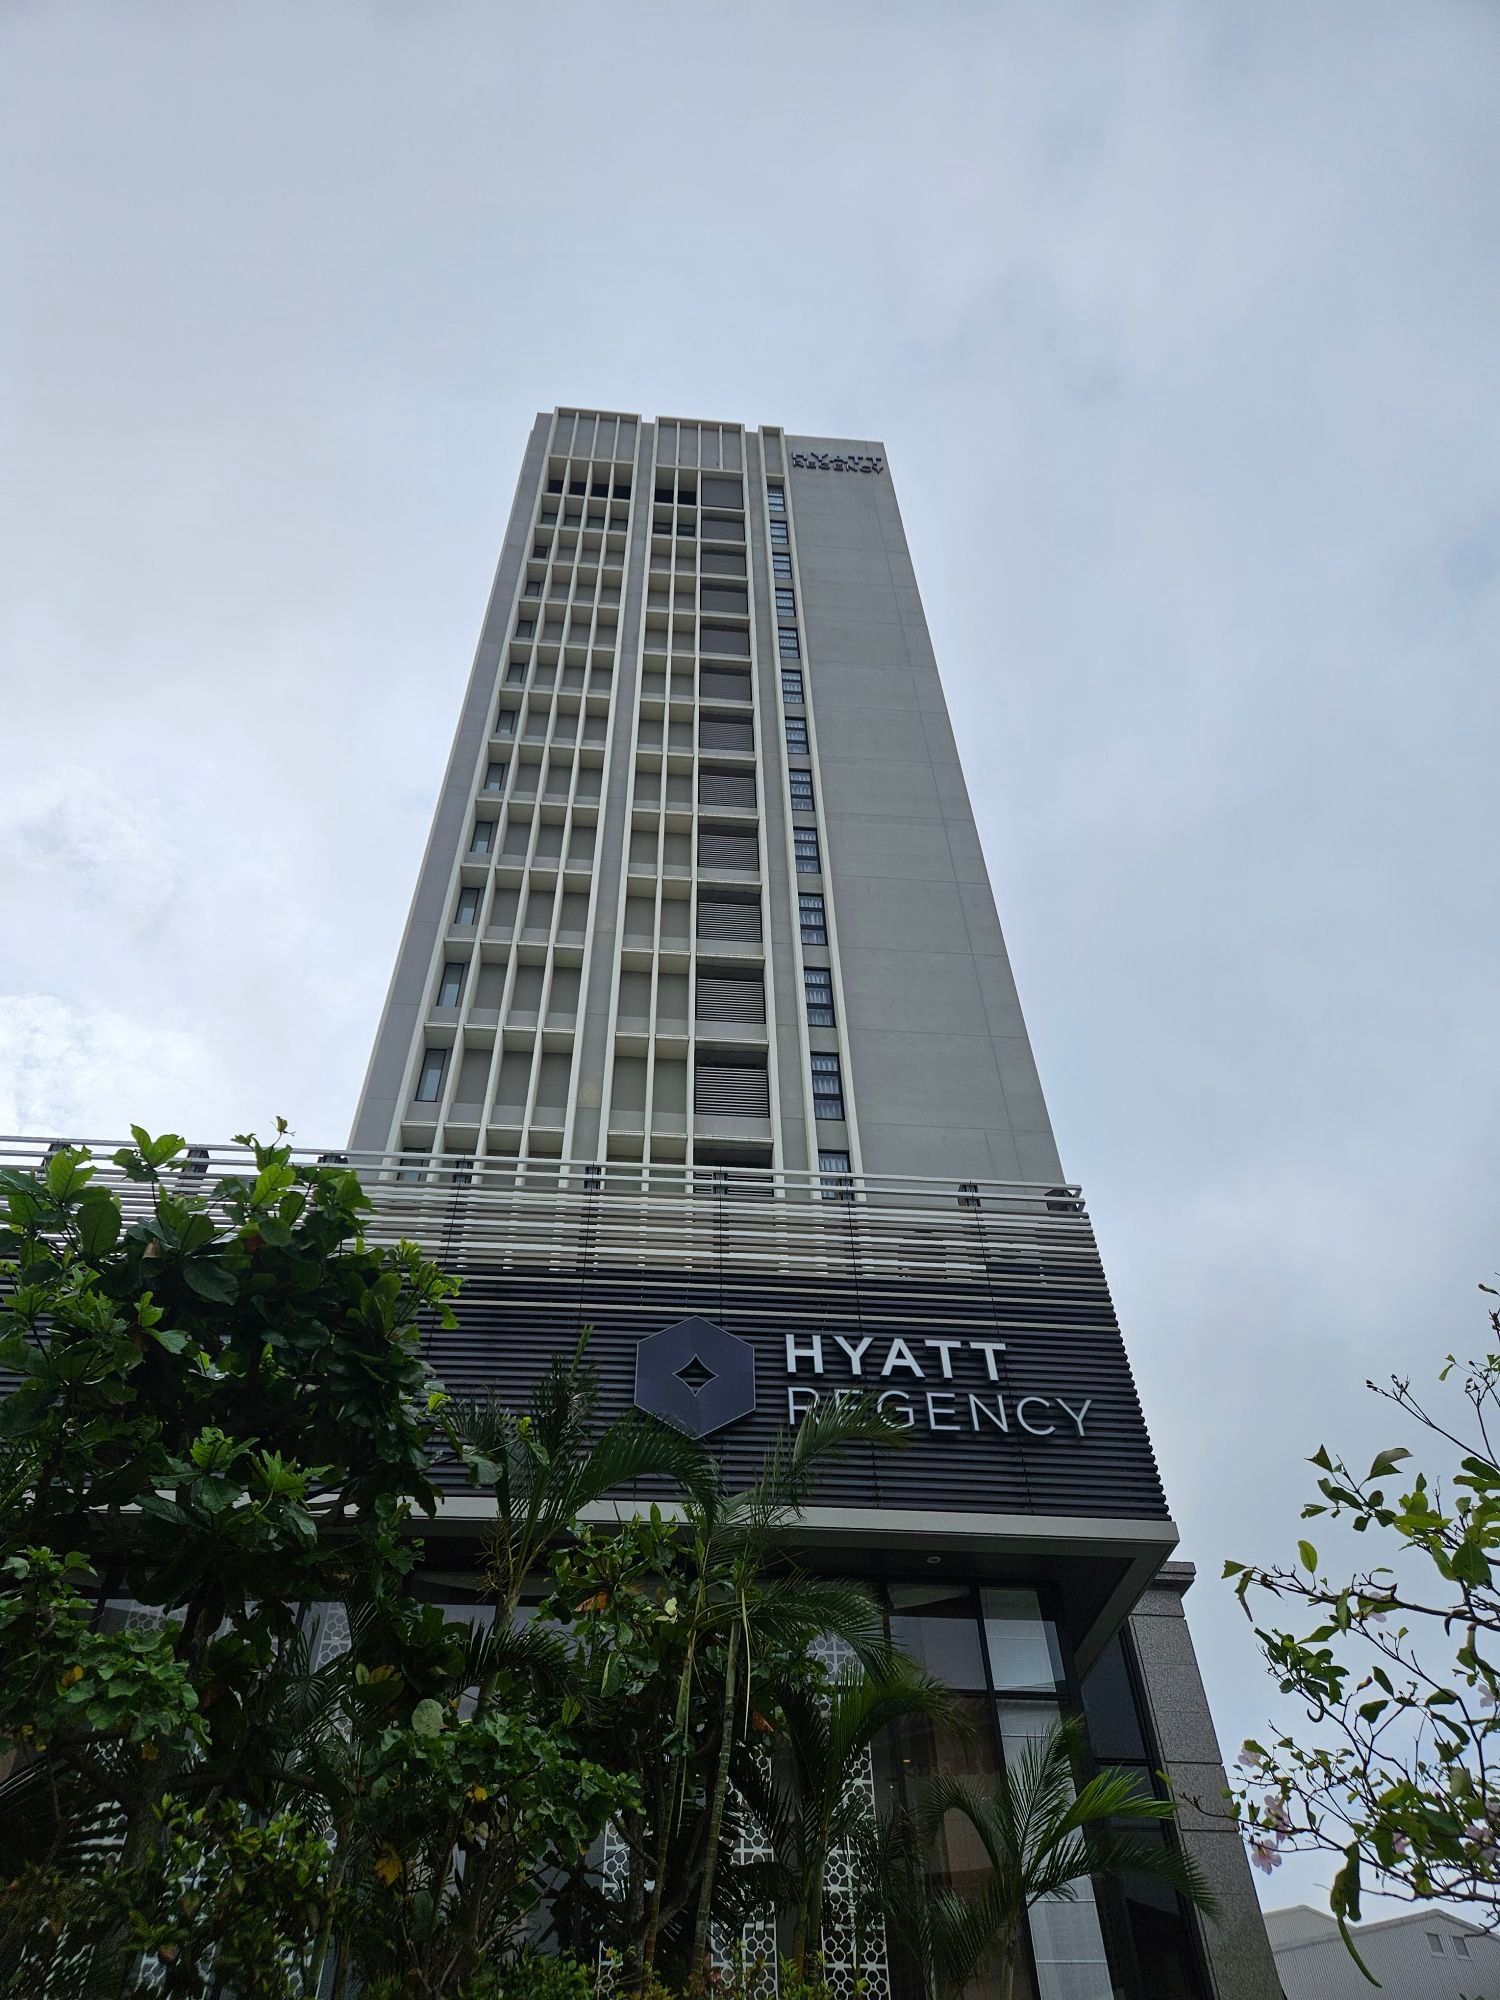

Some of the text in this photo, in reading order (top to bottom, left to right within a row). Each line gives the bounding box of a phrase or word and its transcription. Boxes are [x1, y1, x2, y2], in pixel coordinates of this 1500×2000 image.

[792, 450, 882, 466] HYATT
[793, 460, 884, 474] REGENCY
[785, 1333, 1007, 1382] HYATT
